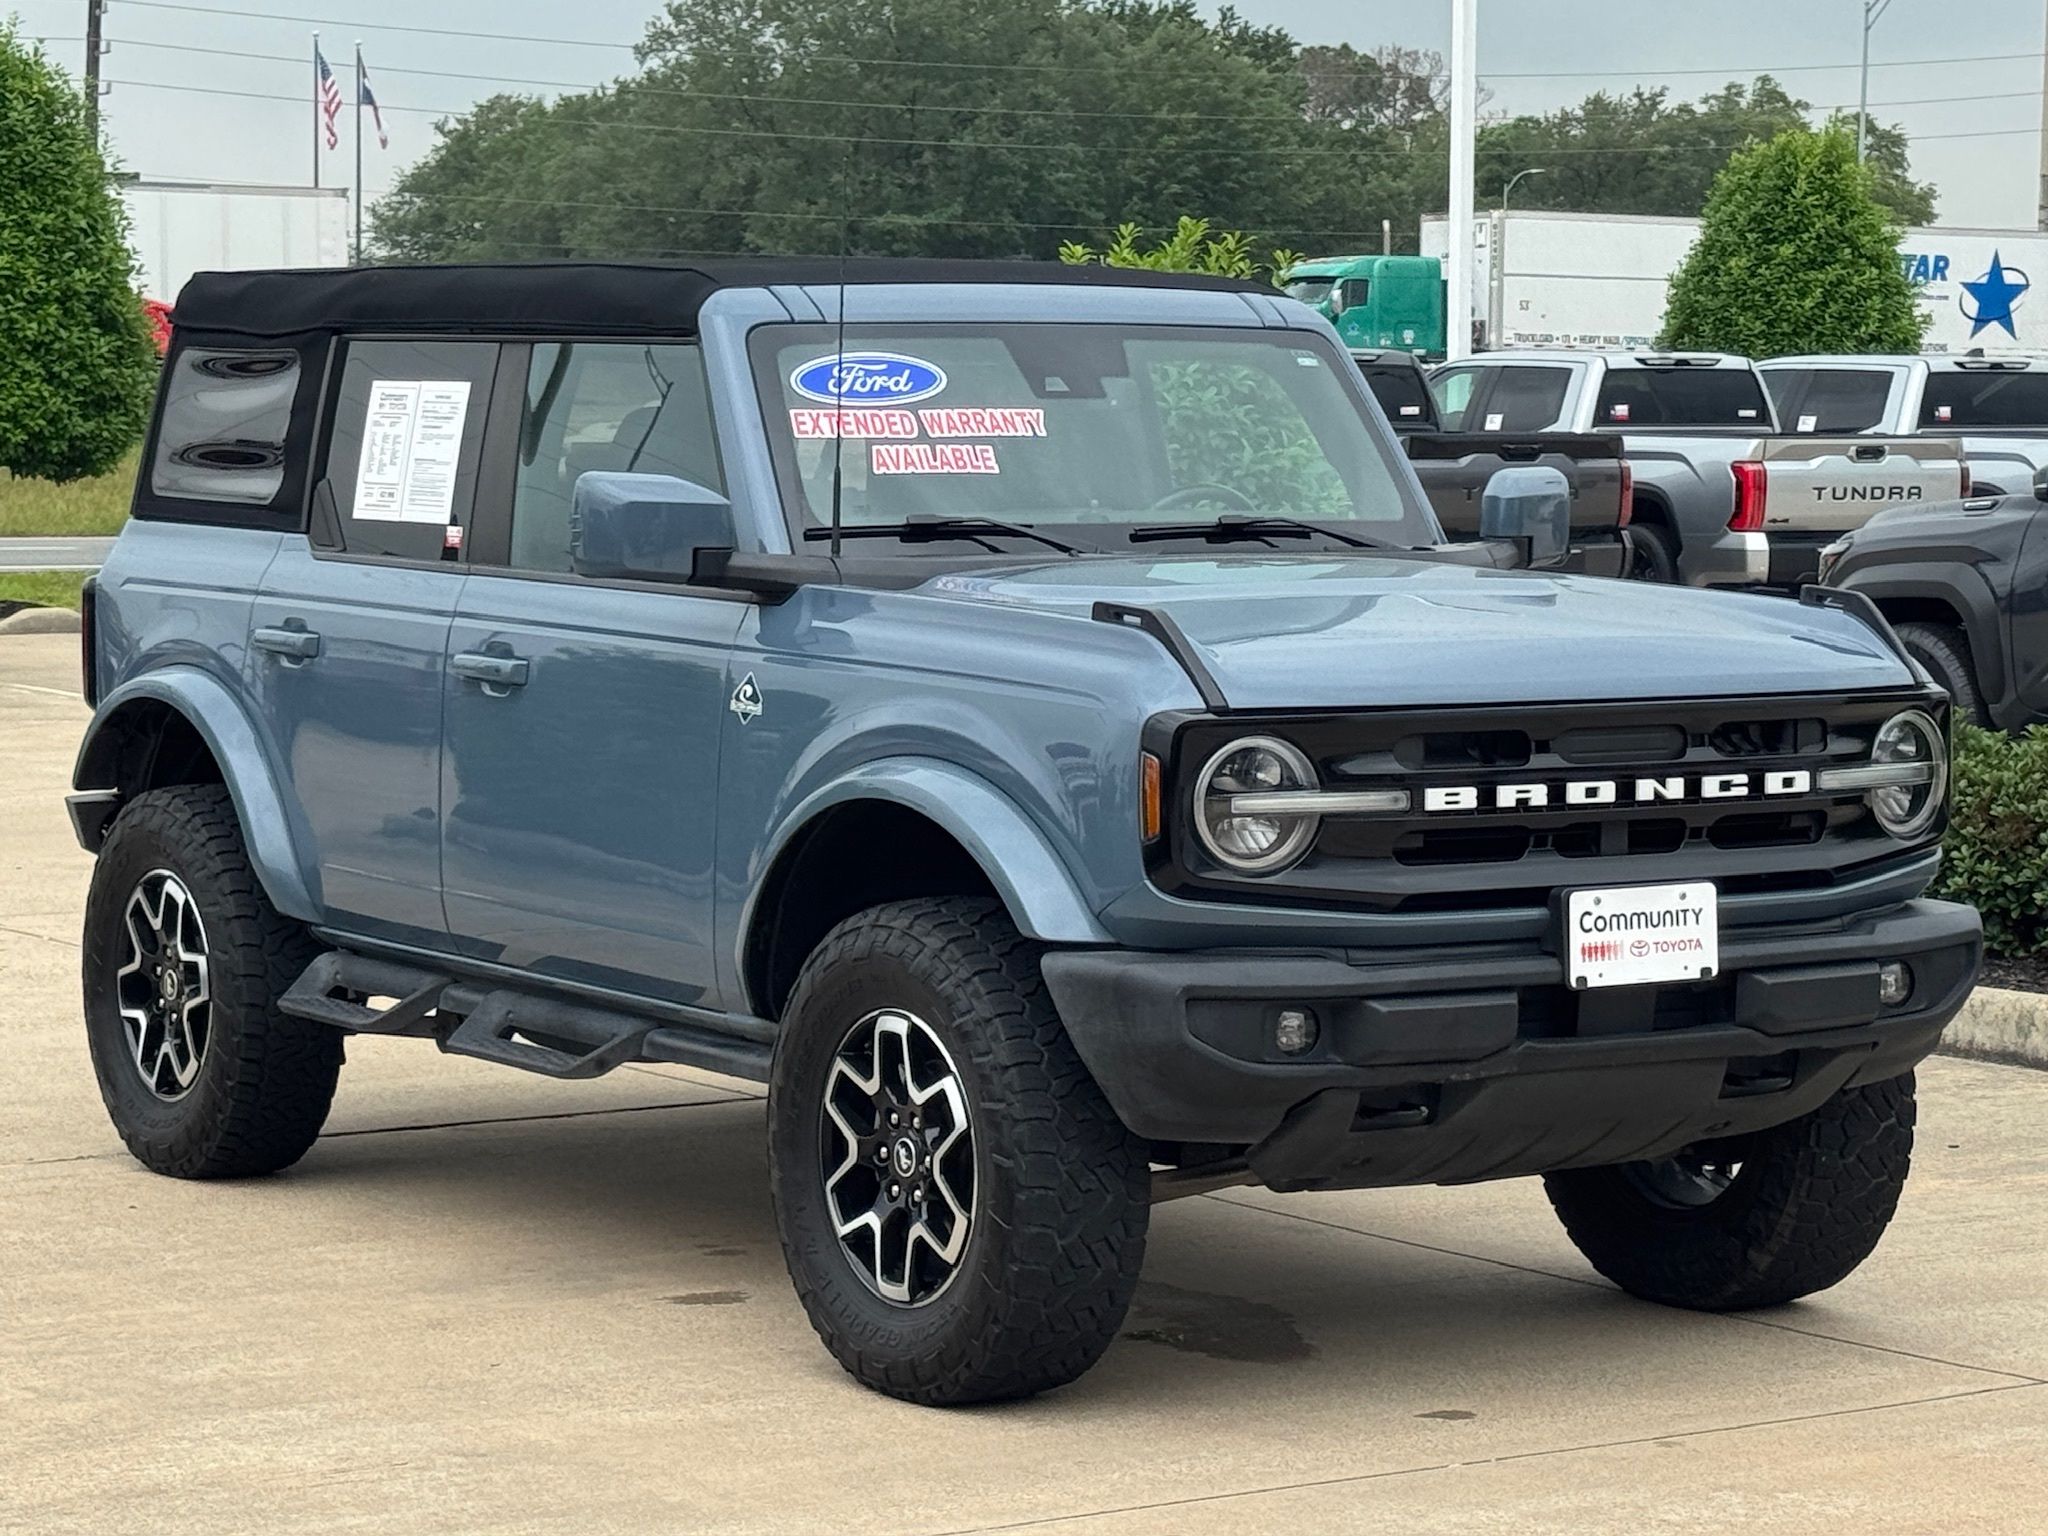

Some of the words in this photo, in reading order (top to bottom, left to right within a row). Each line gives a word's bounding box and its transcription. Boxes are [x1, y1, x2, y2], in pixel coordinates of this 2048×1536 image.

[828, 363, 914, 393] Ford
[791, 410, 916, 438] EXTENDED
[919, 410, 1046, 437] WARRANTY
[873, 447, 997, 473] AVAILABLE
[1812, 485, 1922, 501] TUNDRA
[1424, 770, 1811, 812] BRONCO
[1652, 938, 1704, 955] TOYOTA
